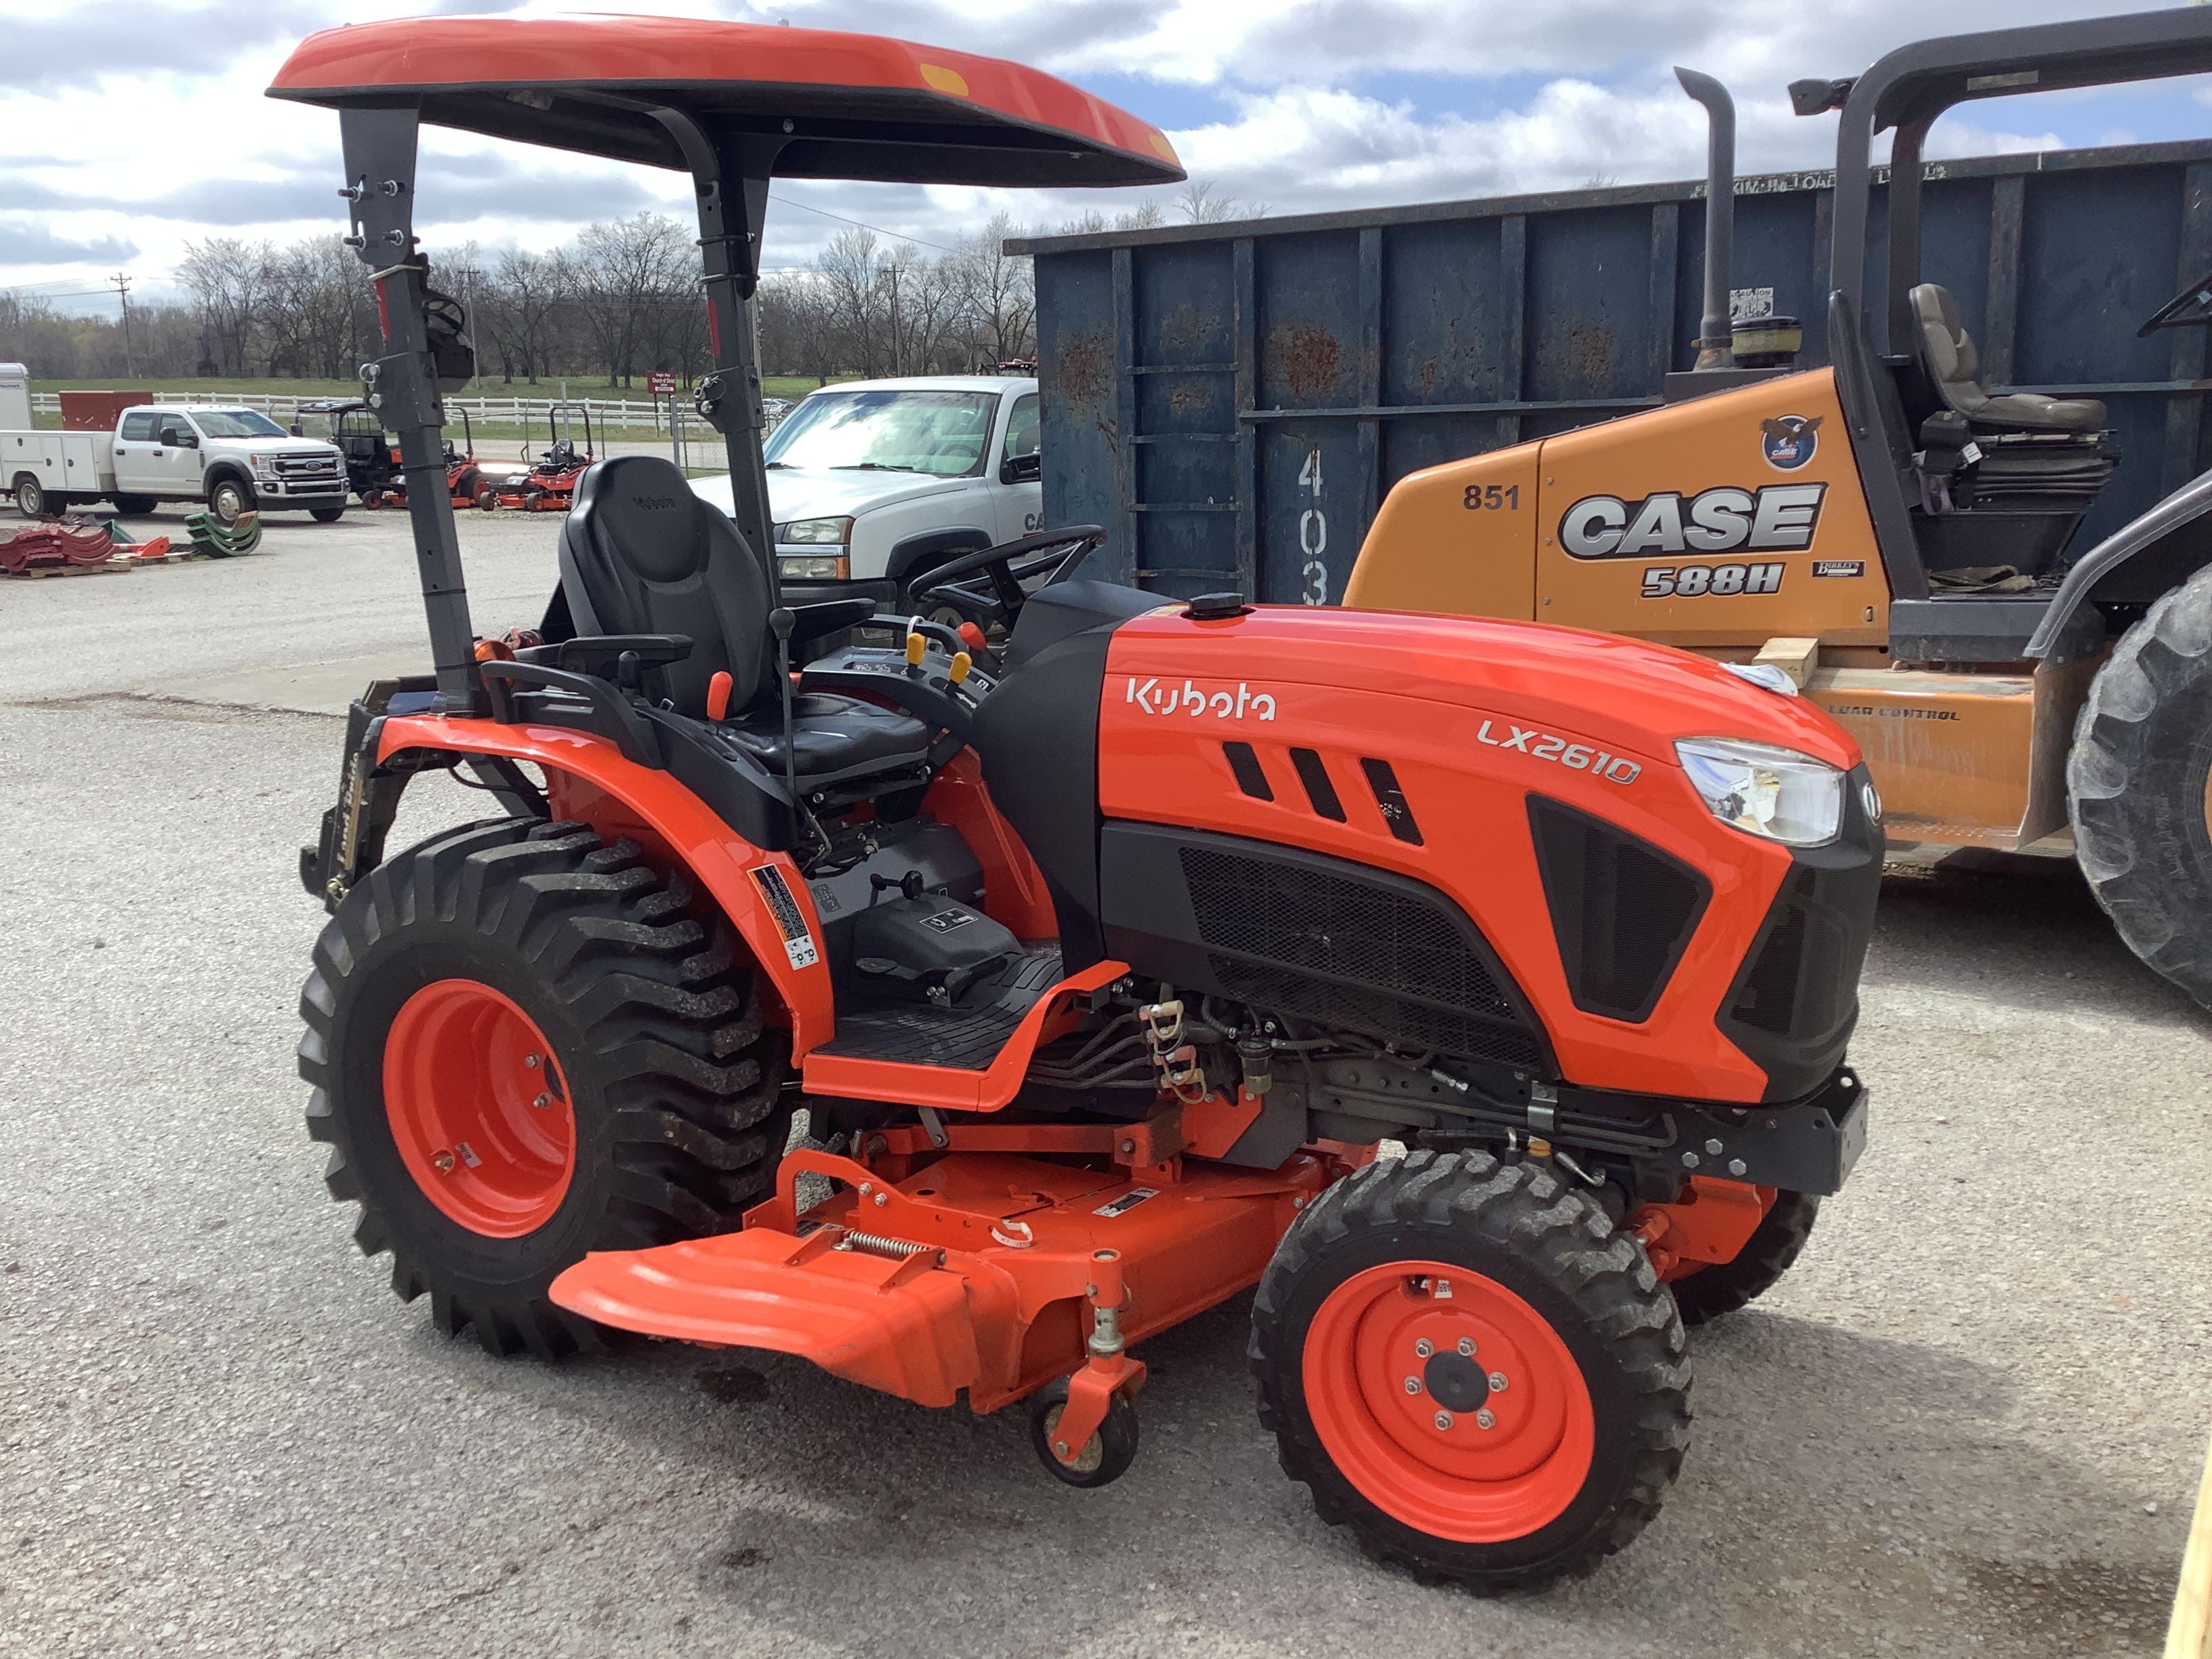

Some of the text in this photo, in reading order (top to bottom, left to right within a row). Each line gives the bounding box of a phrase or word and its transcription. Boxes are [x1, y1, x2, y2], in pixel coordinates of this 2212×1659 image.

[1463, 485, 1519, 510] 851
[1559, 483, 1826, 557] CASE
[1642, 564, 1784, 596] 588H
[1126, 677, 1277, 722] Kubota
[1879, 708, 1961, 721] CONTROL
[1476, 719, 1643, 785] LX2610
